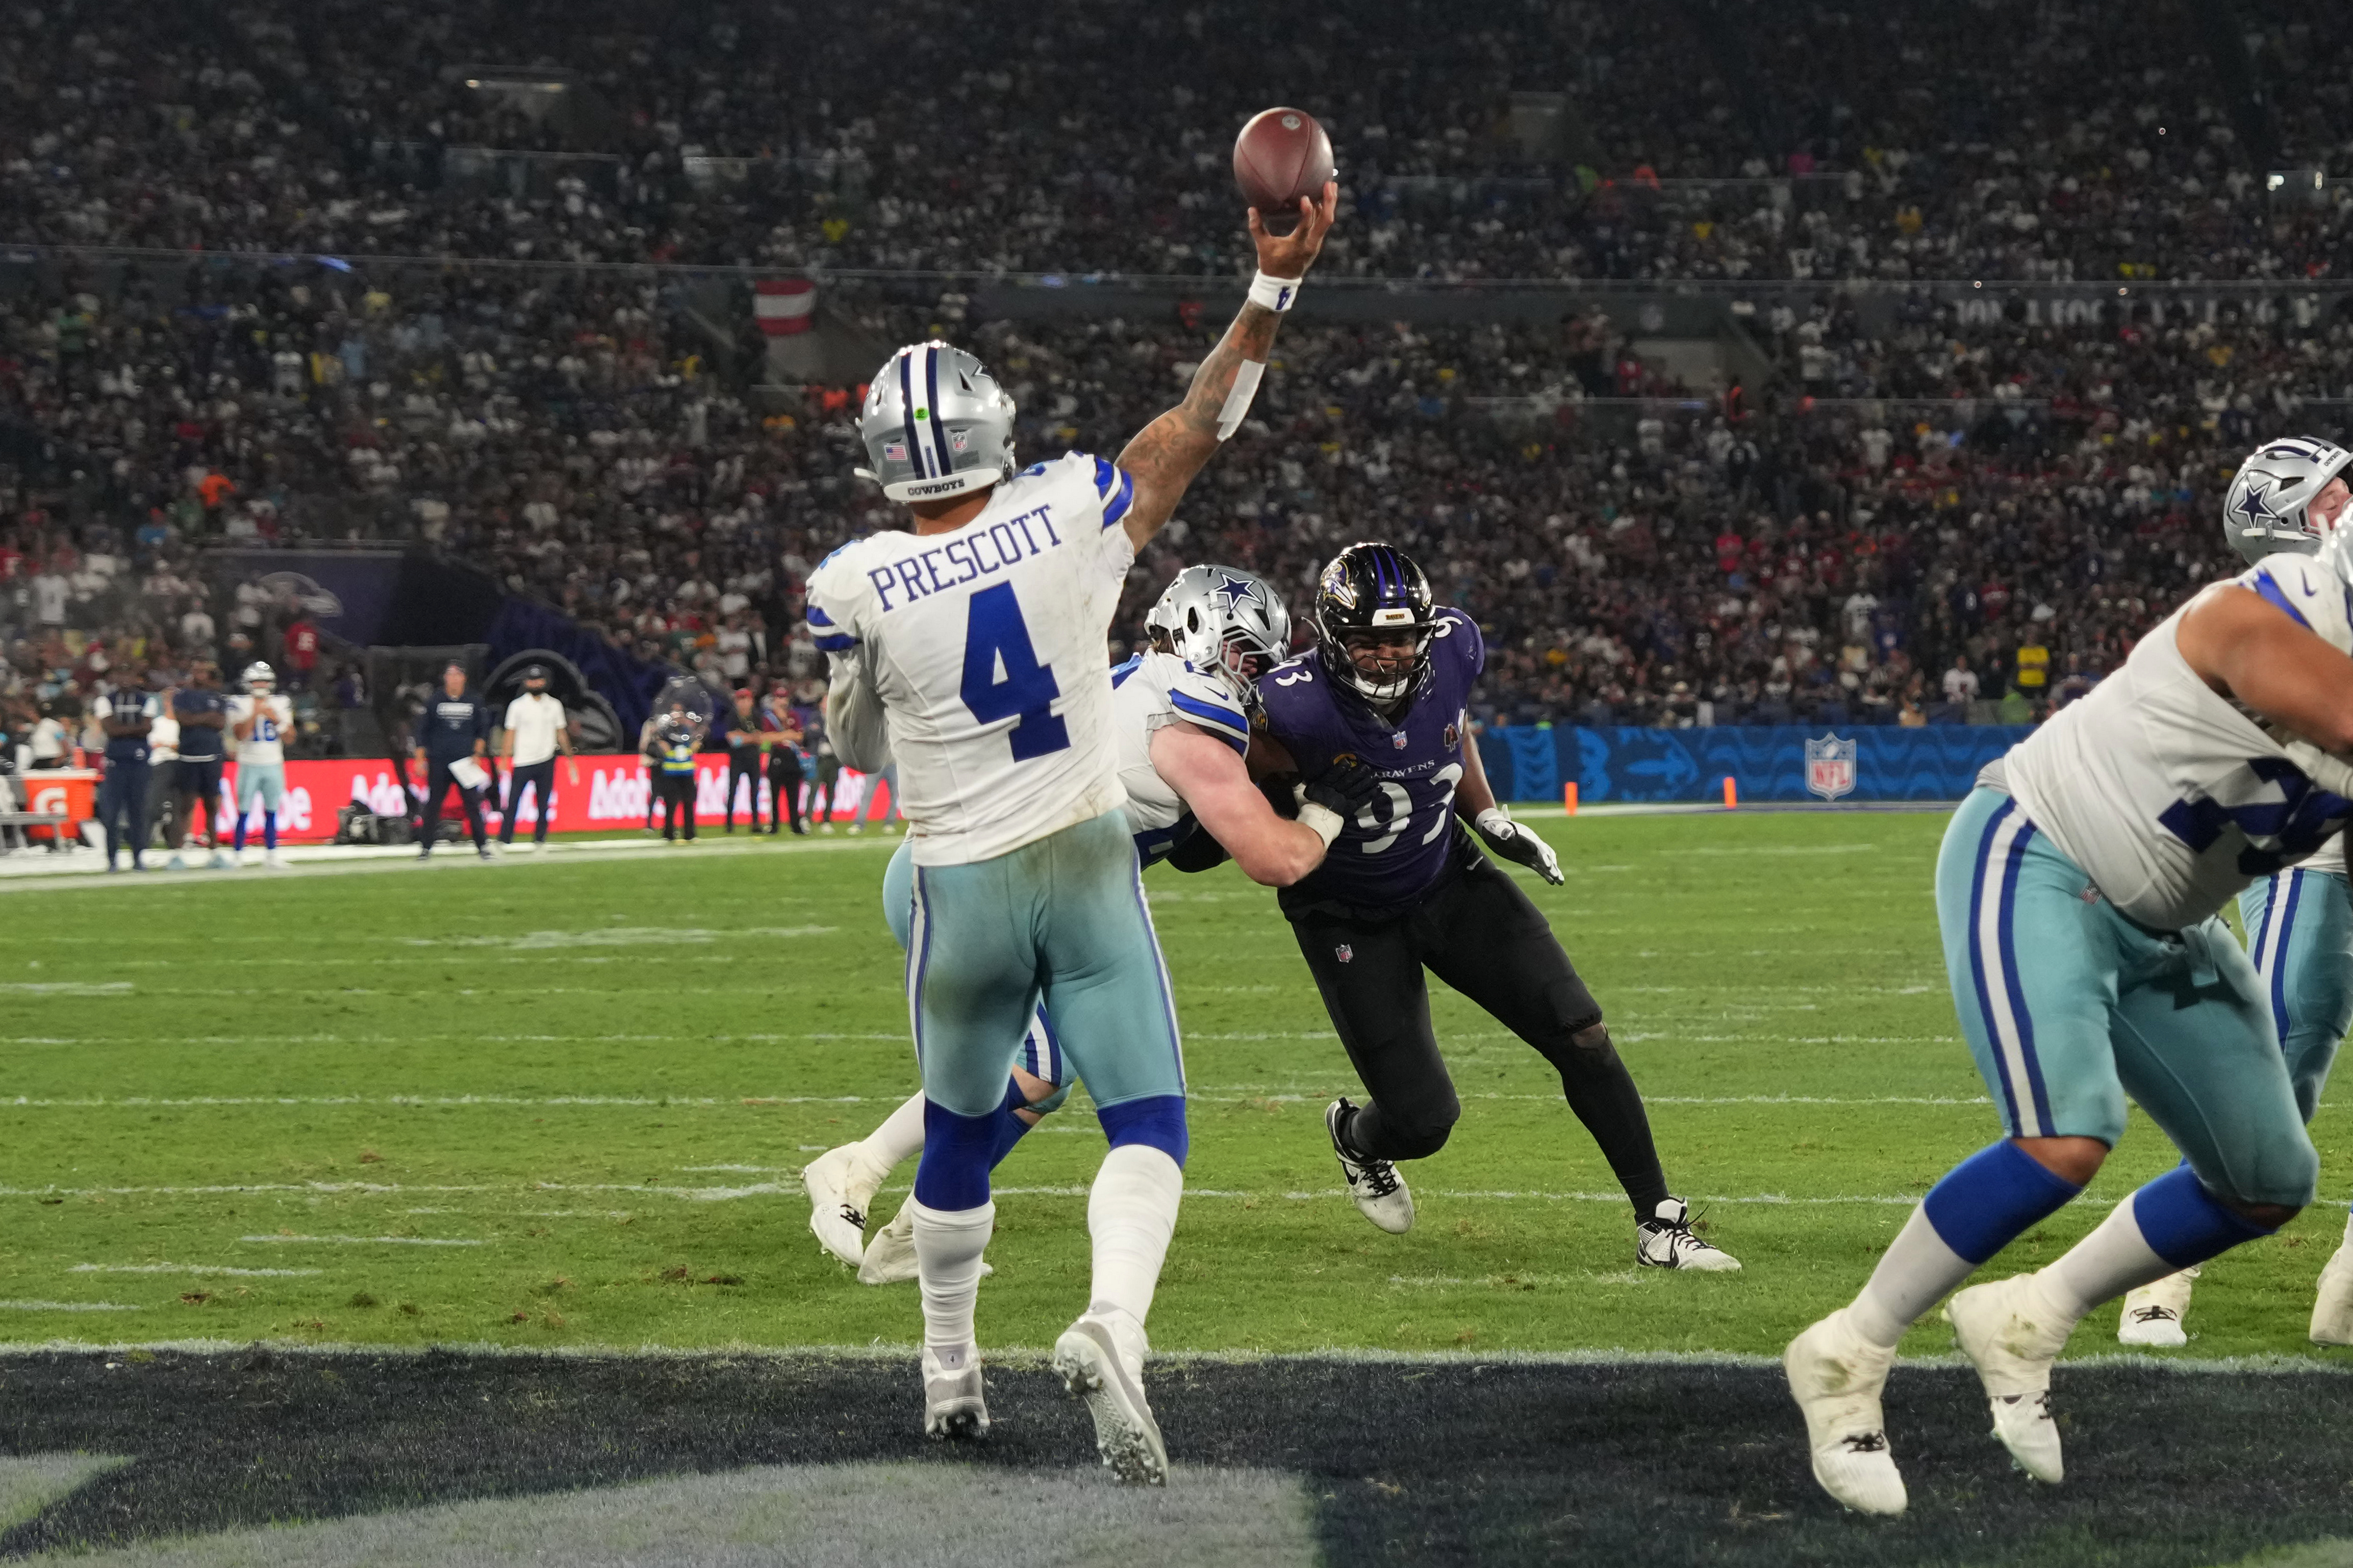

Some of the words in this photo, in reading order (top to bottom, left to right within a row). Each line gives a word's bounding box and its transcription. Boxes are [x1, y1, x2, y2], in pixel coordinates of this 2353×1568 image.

[954, 441, 967, 449] NFL
[908, 478, 965, 496] COWBOYS
[867, 503, 1061, 612] PRESCOTT
[960, 579, 1072, 763] 4
[1381, 759, 1435, 778] RAVENS
[1812, 760, 1850, 786] NFL
[34, 787, 67, 815] G
